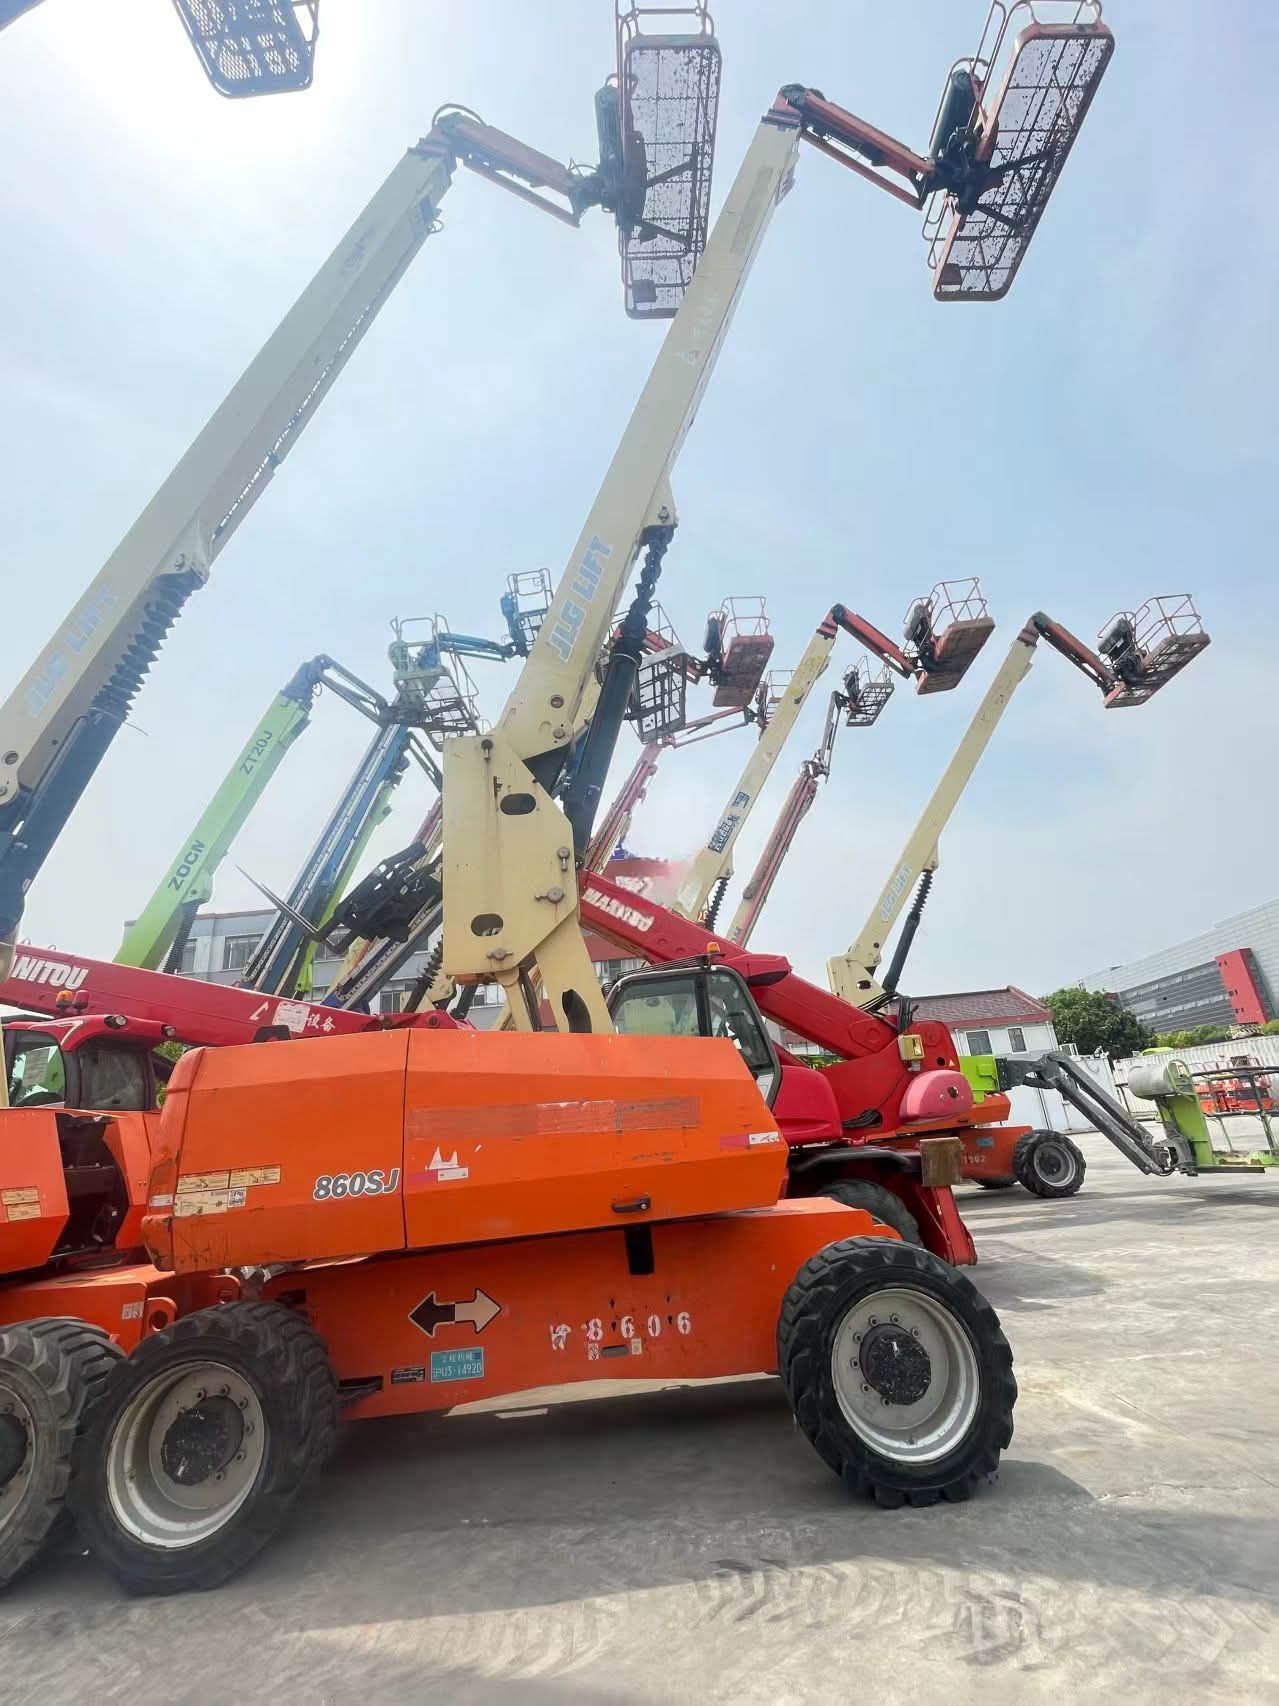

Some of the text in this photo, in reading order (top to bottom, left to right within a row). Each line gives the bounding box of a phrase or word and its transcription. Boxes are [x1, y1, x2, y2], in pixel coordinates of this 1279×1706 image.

[569, 535, 616, 603] LIFT
[239, 730, 273, 775] ZT20J
[313, 1167, 400, 1200] 860SJ
